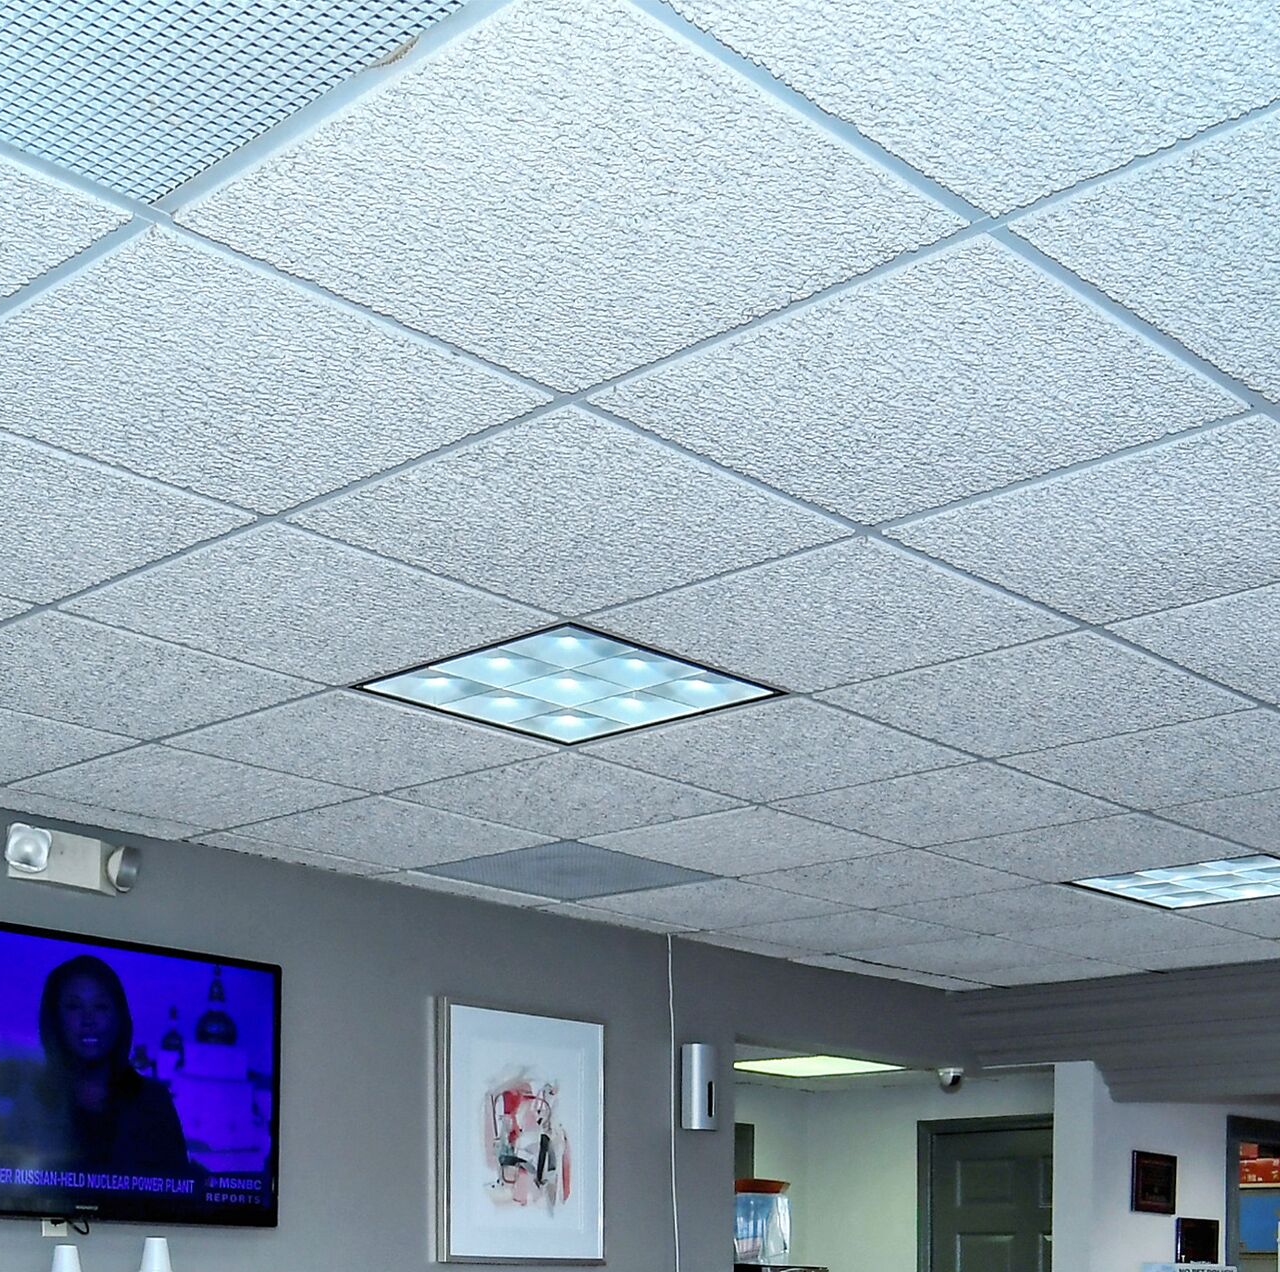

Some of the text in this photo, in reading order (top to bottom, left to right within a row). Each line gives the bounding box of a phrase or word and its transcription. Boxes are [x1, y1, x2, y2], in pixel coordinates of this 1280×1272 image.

[14, 1170, 85, 1188] RUSSIAN-HELD
[87, 1173, 130, 1191] NUCLEAR
[131, 1175, 163, 1192] POWER
[165, 1178, 195, 1194] PLANT
[219, 1177, 262, 1190] MSNBC
[206, 1192, 262, 1205] REPORTS
